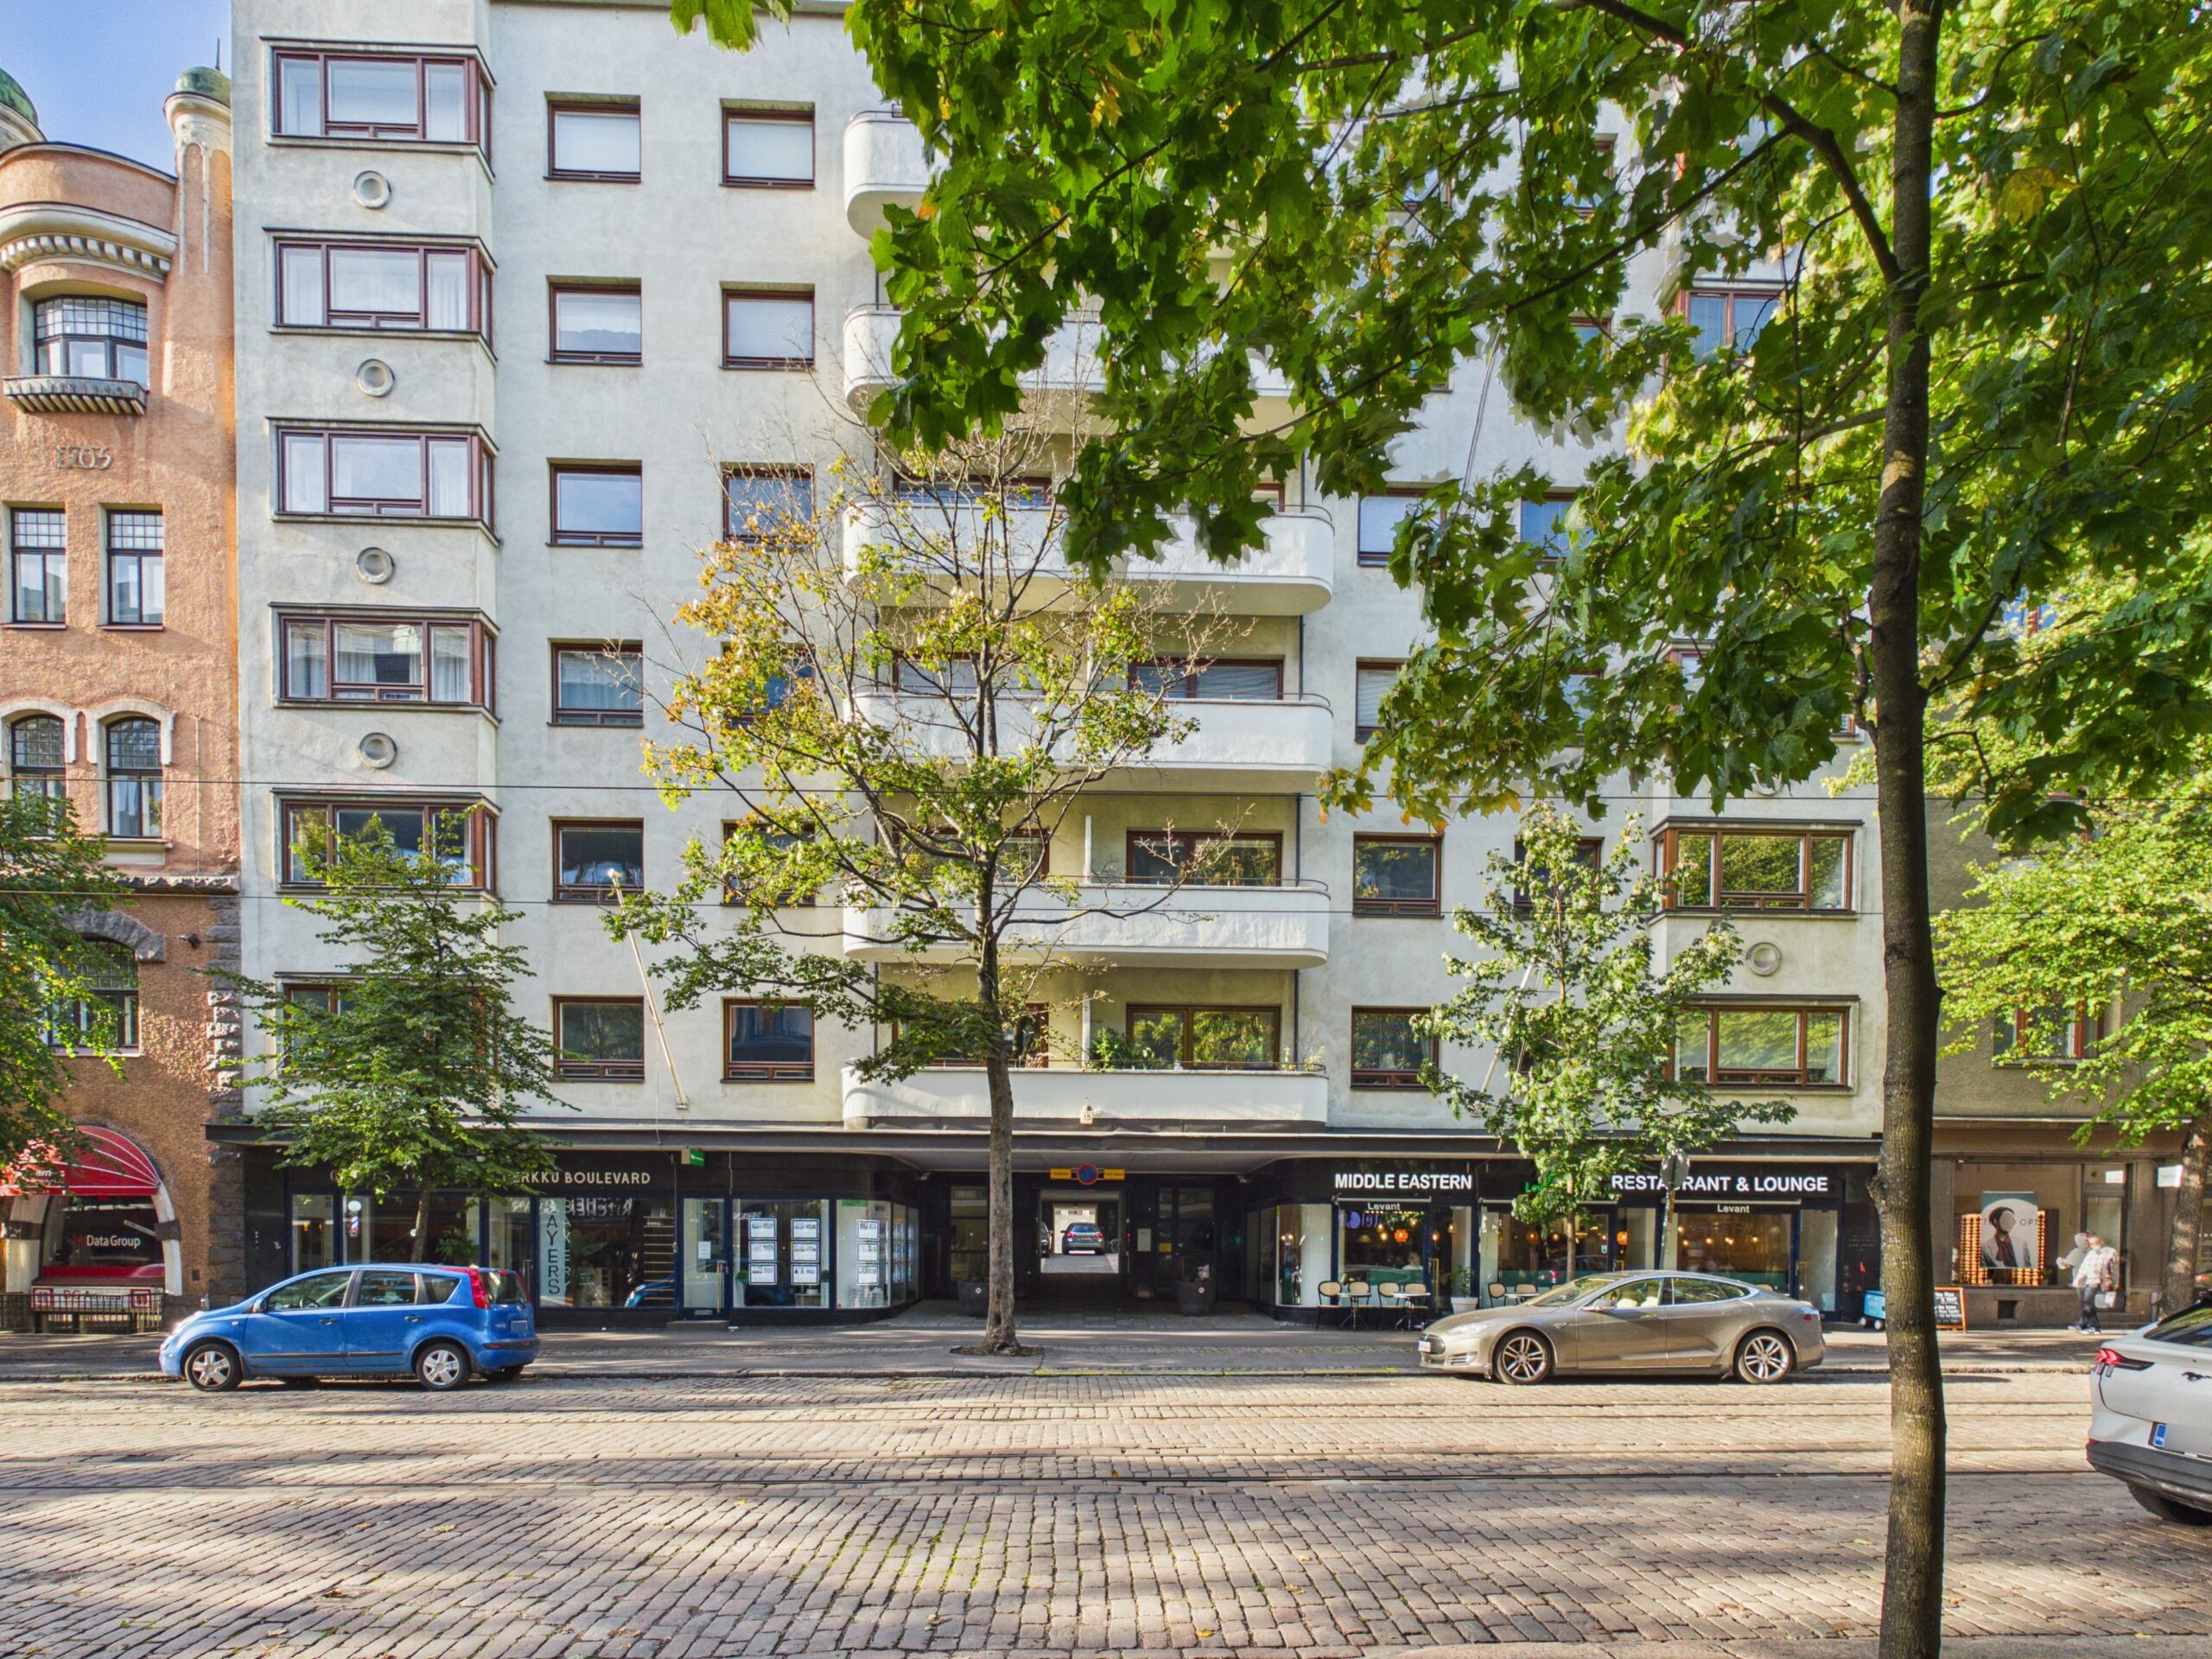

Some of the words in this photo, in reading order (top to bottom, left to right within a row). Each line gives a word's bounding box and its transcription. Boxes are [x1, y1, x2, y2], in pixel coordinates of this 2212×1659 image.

[564, 1172, 651, 1184] BOULEVARD
[1335, 1173, 1395, 1189] MIDDLE
[1398, 1174, 1472, 1190] EASTERN
[1611, 1174, 1731, 1192] RESTARANT
[1735, 1176, 1750, 1192] &
[1754, 1176, 1828, 1192] LOUNGE
[1367, 1202, 1401, 1211] Levant
[1717, 1204, 1751, 1213] Levant
